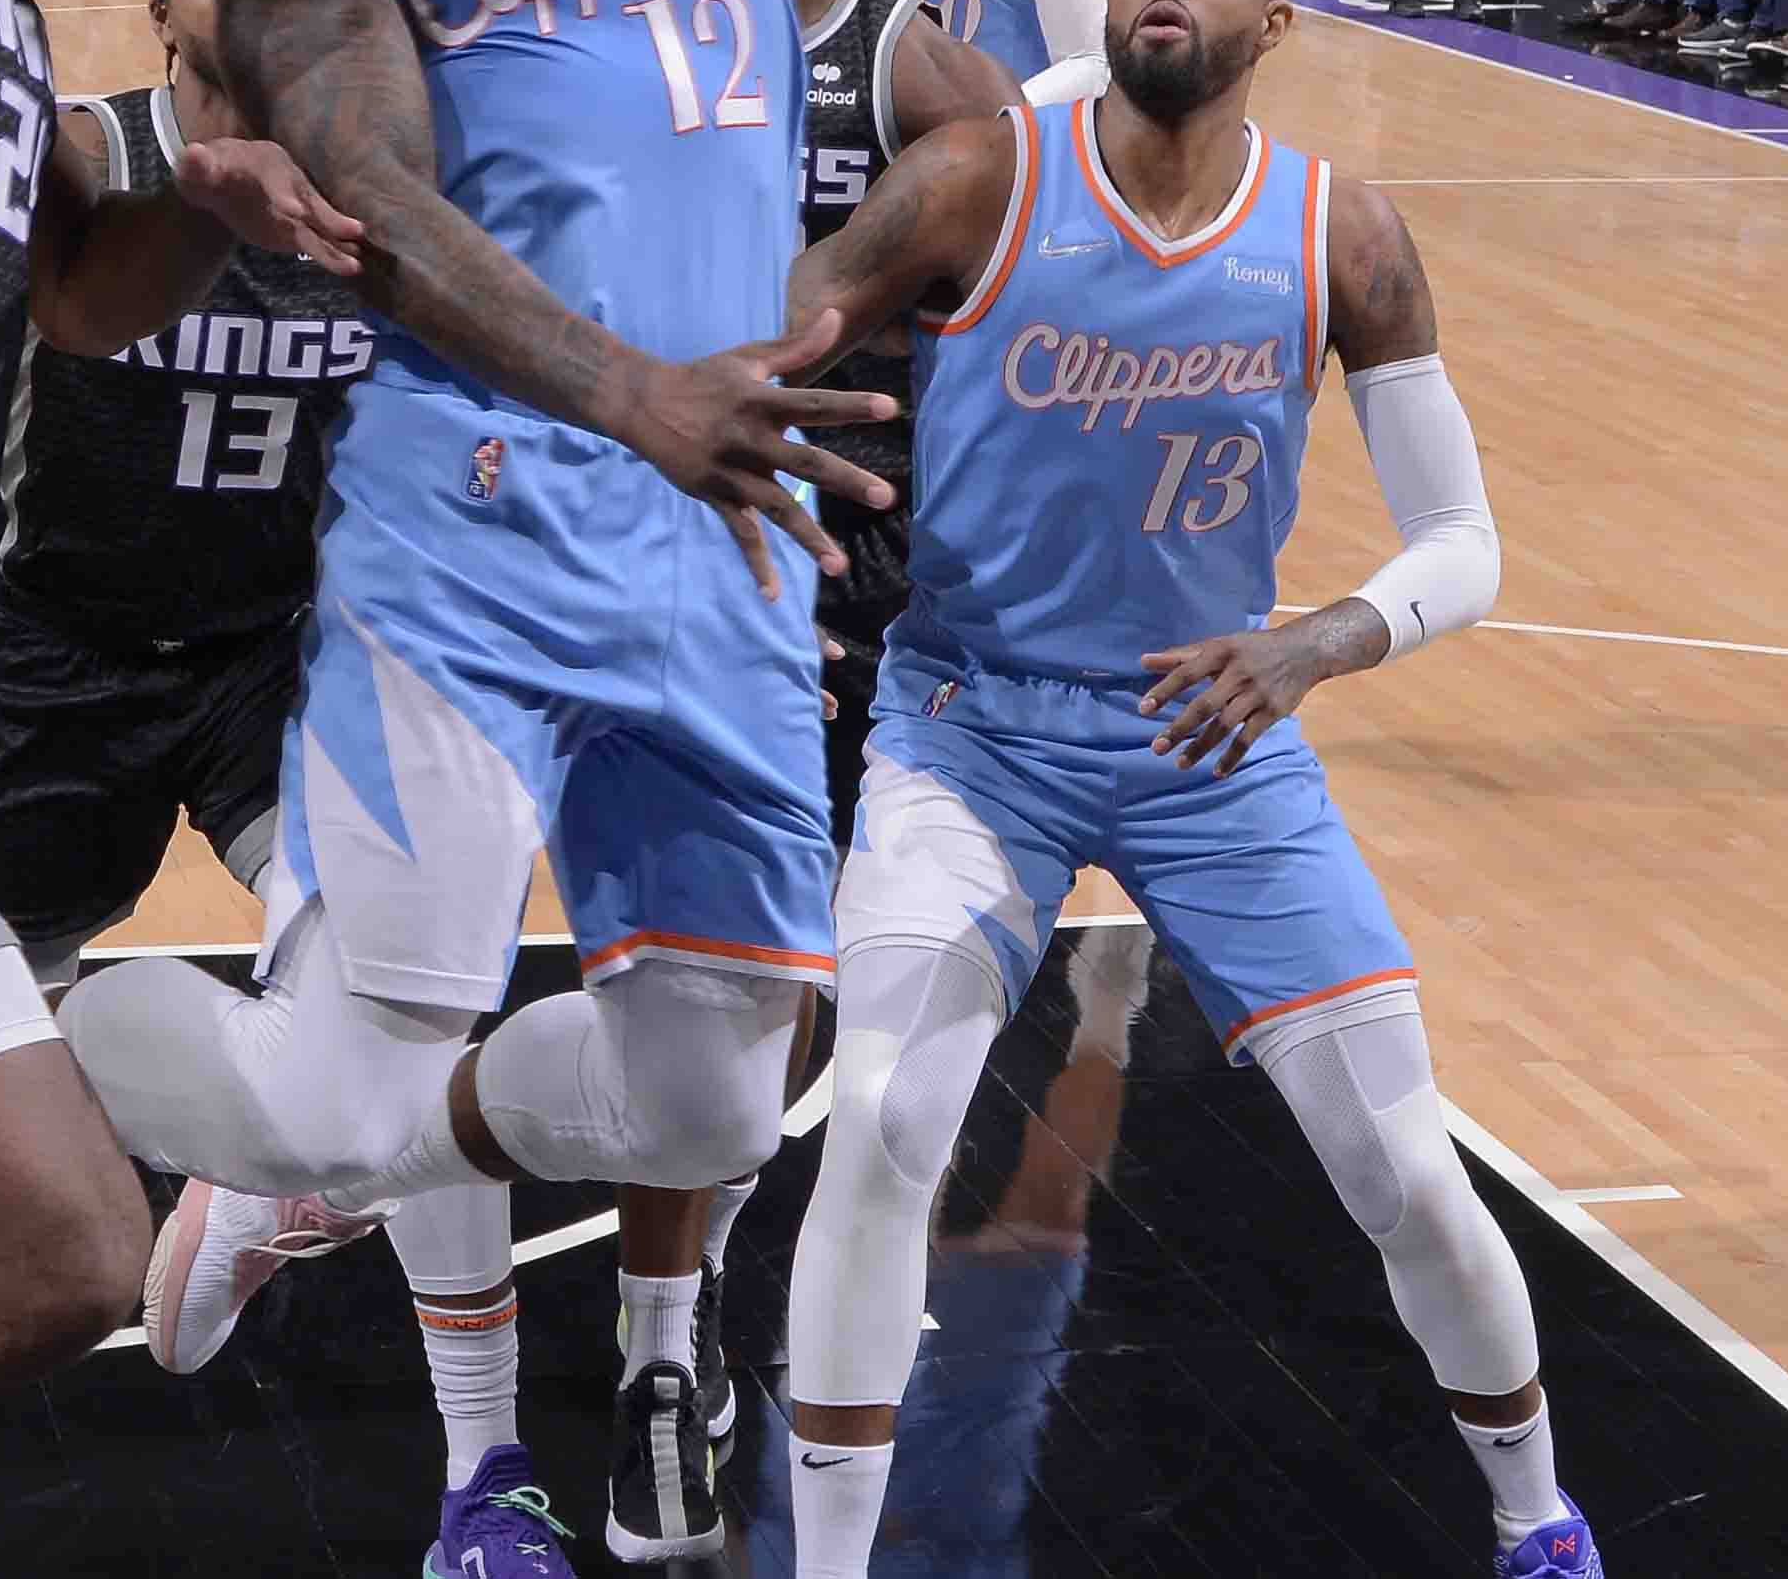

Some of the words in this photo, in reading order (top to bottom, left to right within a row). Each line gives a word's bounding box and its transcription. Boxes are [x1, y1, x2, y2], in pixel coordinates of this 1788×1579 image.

[1001, 322, 1284, 432] Clippers
[175, 390, 299, 490] 13
[1141, 433, 1261, 533] 13
